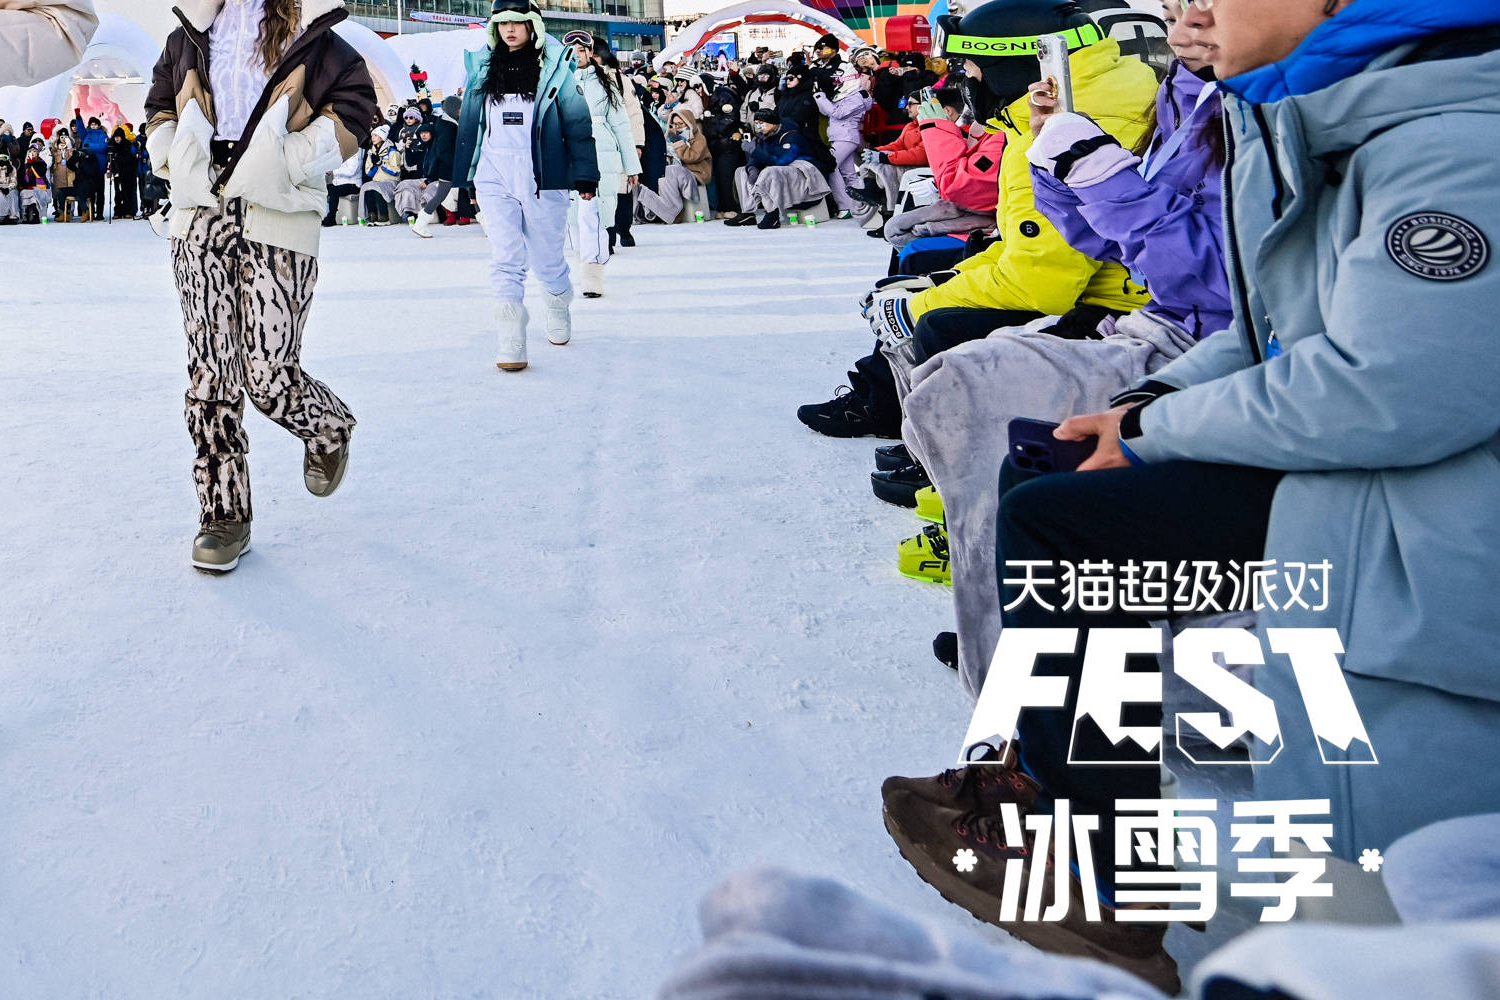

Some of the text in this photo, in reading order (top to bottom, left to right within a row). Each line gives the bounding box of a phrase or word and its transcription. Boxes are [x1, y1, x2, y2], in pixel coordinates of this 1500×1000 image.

[960, 39, 1038, 52] BOGNE
[1410, 216, 1476, 241] BOSIDENG
[885, 299, 903, 338] BOGNER
